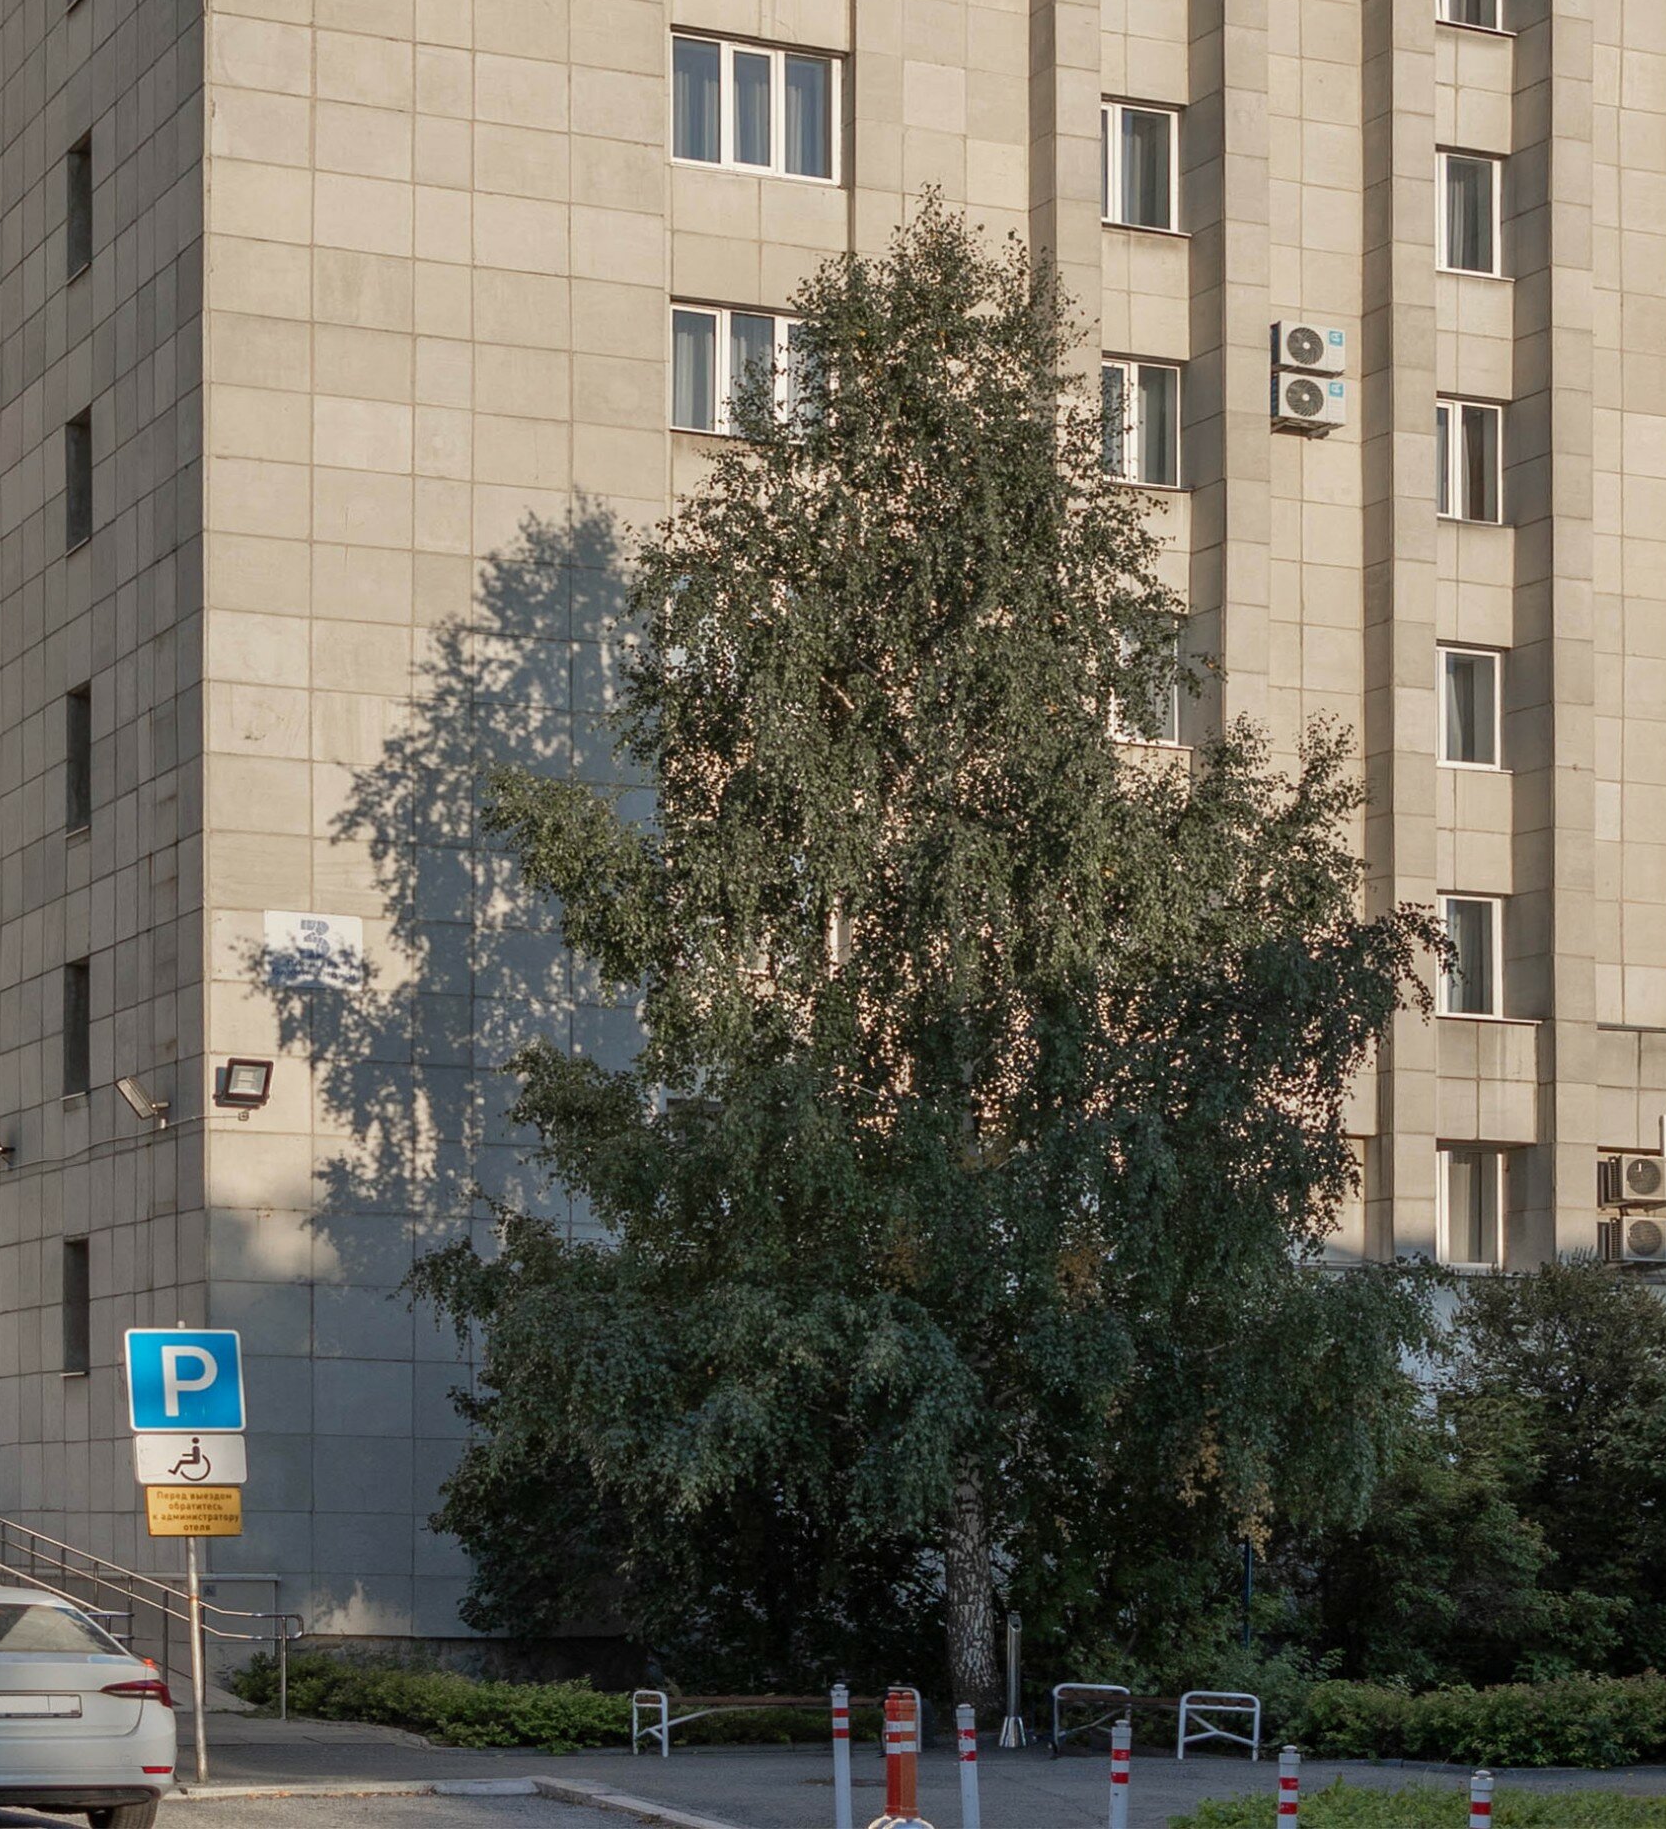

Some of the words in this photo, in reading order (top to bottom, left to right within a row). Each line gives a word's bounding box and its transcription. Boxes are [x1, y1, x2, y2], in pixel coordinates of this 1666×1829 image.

[161, 1345, 218, 1417] P
[156, 1491, 188, 1500] Перед
[190, 1492, 232, 1500] выездом
[168, 1502, 223, 1511] обратитесь
[161, 1513, 239, 1522] администратору
